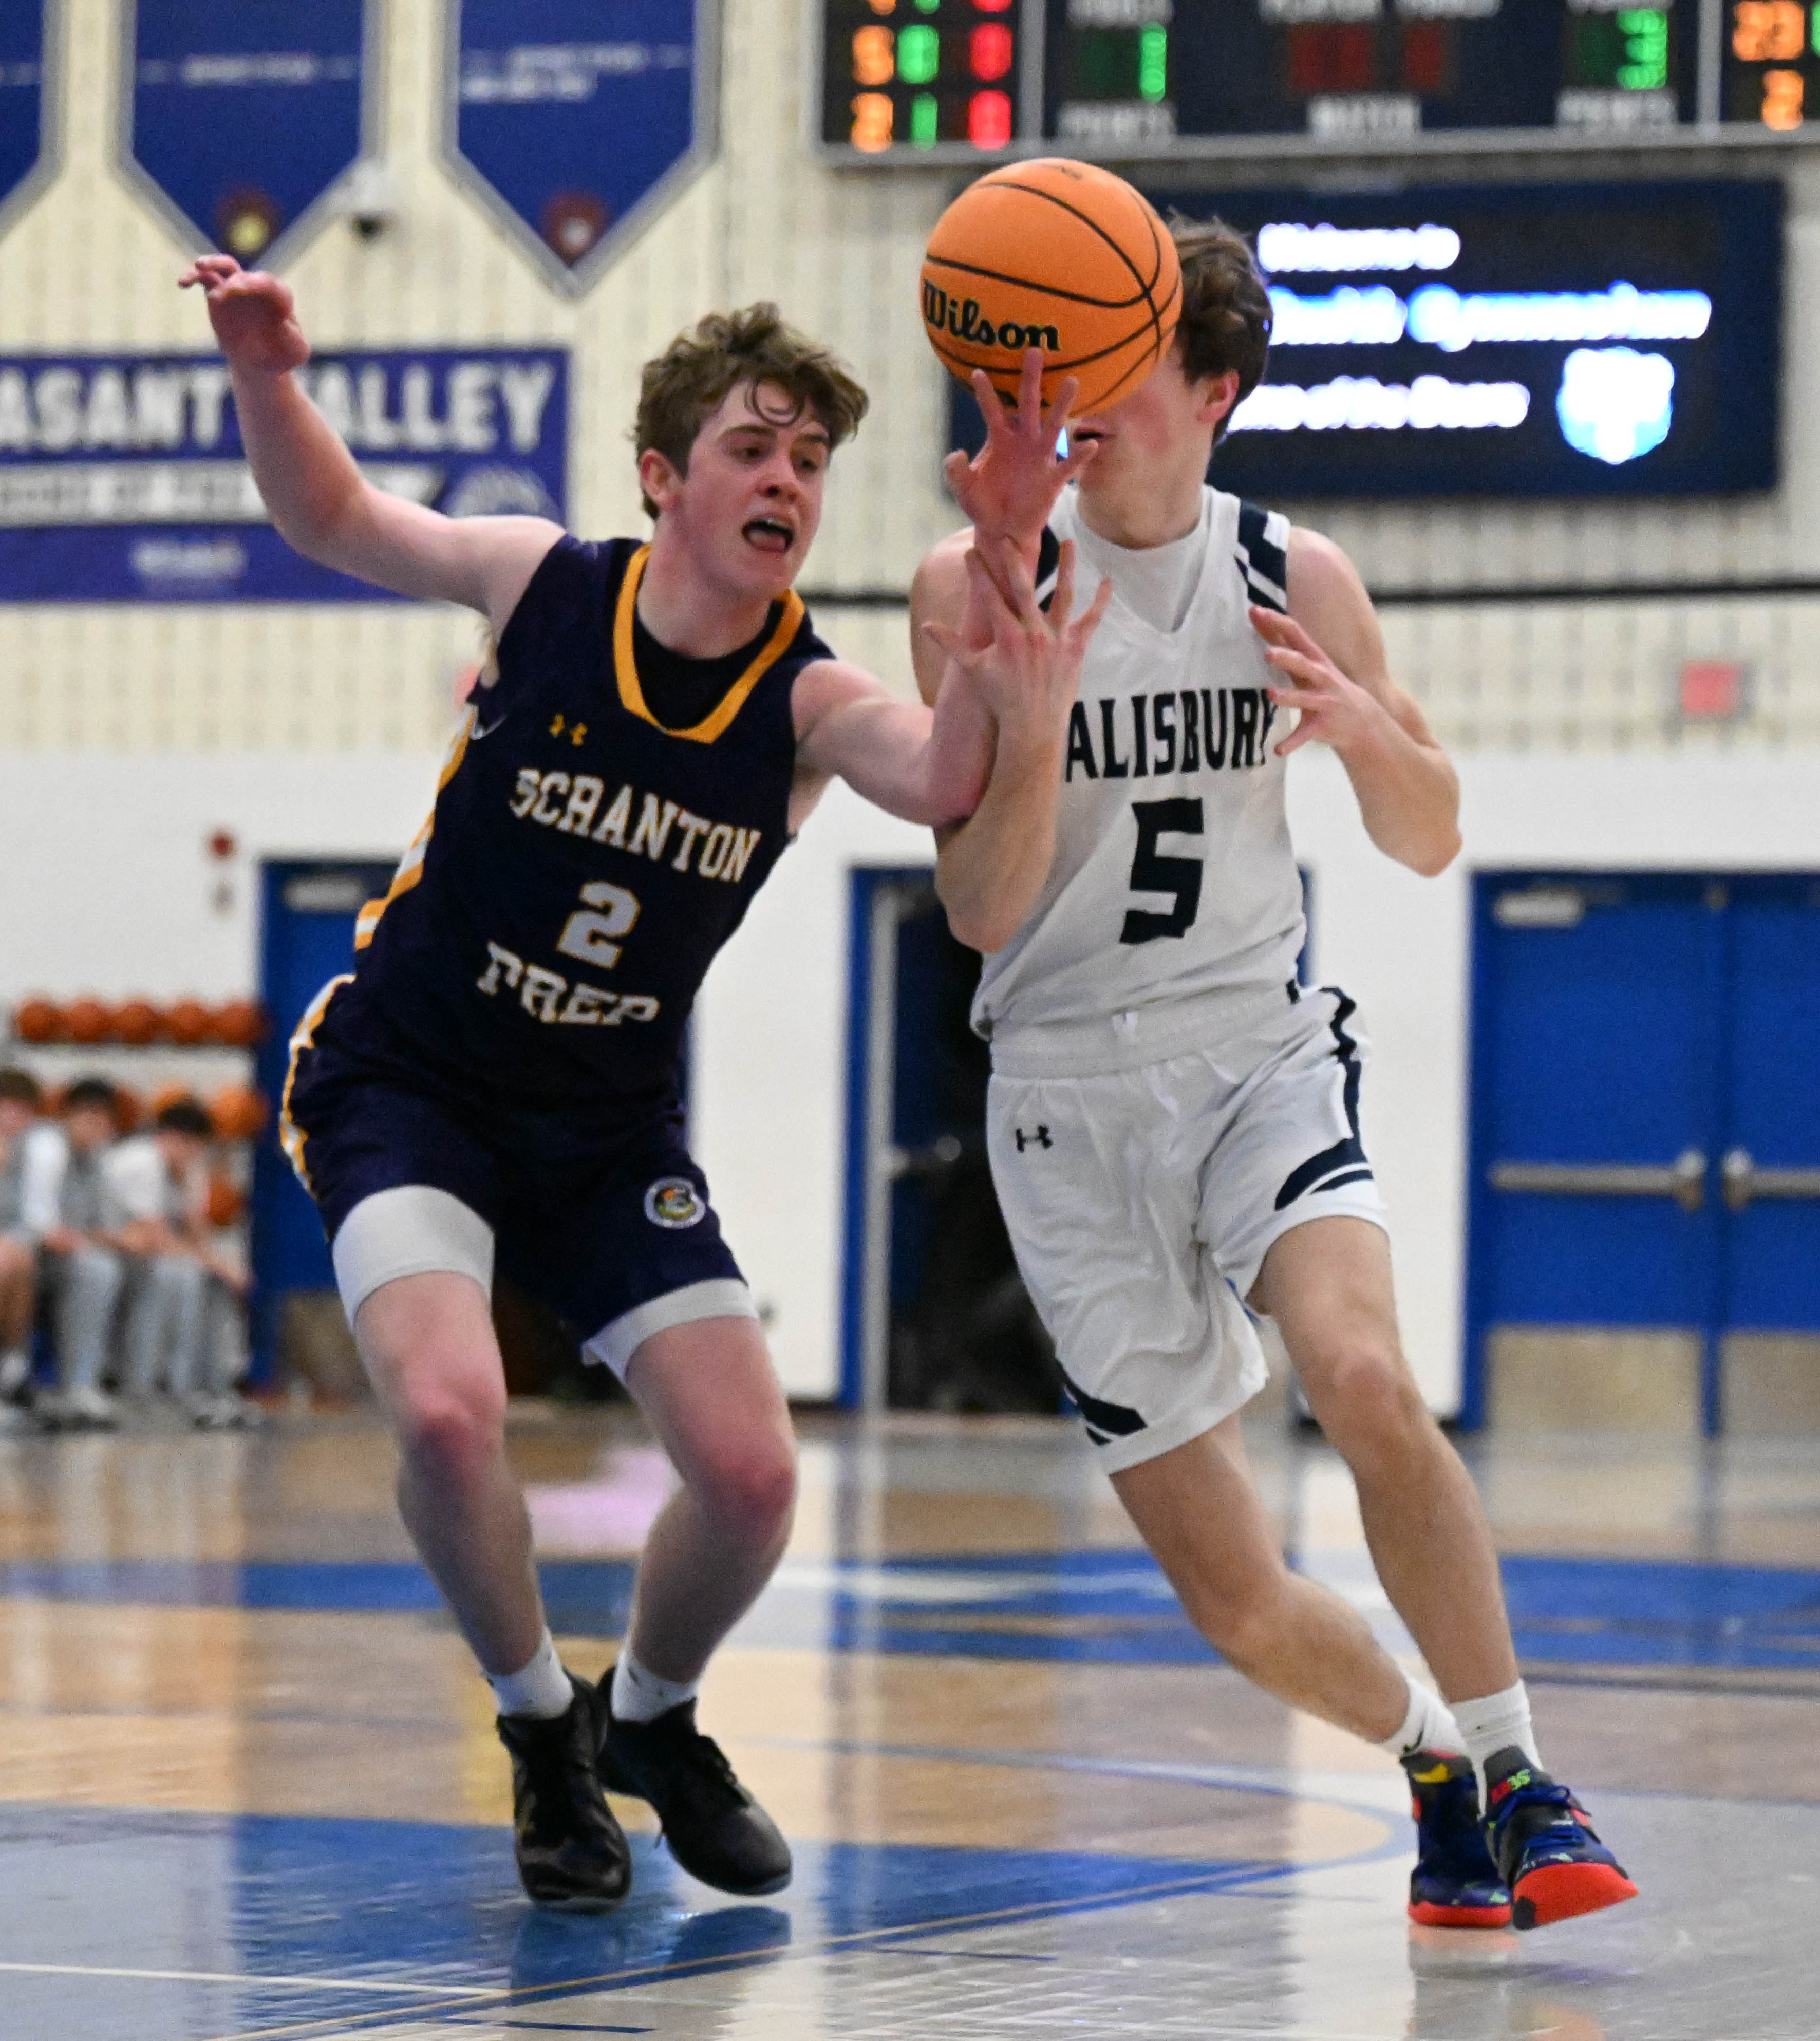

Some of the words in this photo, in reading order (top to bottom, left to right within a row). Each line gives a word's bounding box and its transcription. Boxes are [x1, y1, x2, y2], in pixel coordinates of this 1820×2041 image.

[924, 279, 1061, 350] Wilson
[294, 363, 555, 453] ALLEY
[509, 768, 761, 882] SCRANTON
[1120, 797, 1205, 944] 5
[555, 880, 641, 970] 2
[476, 940, 661, 1025] PREP
